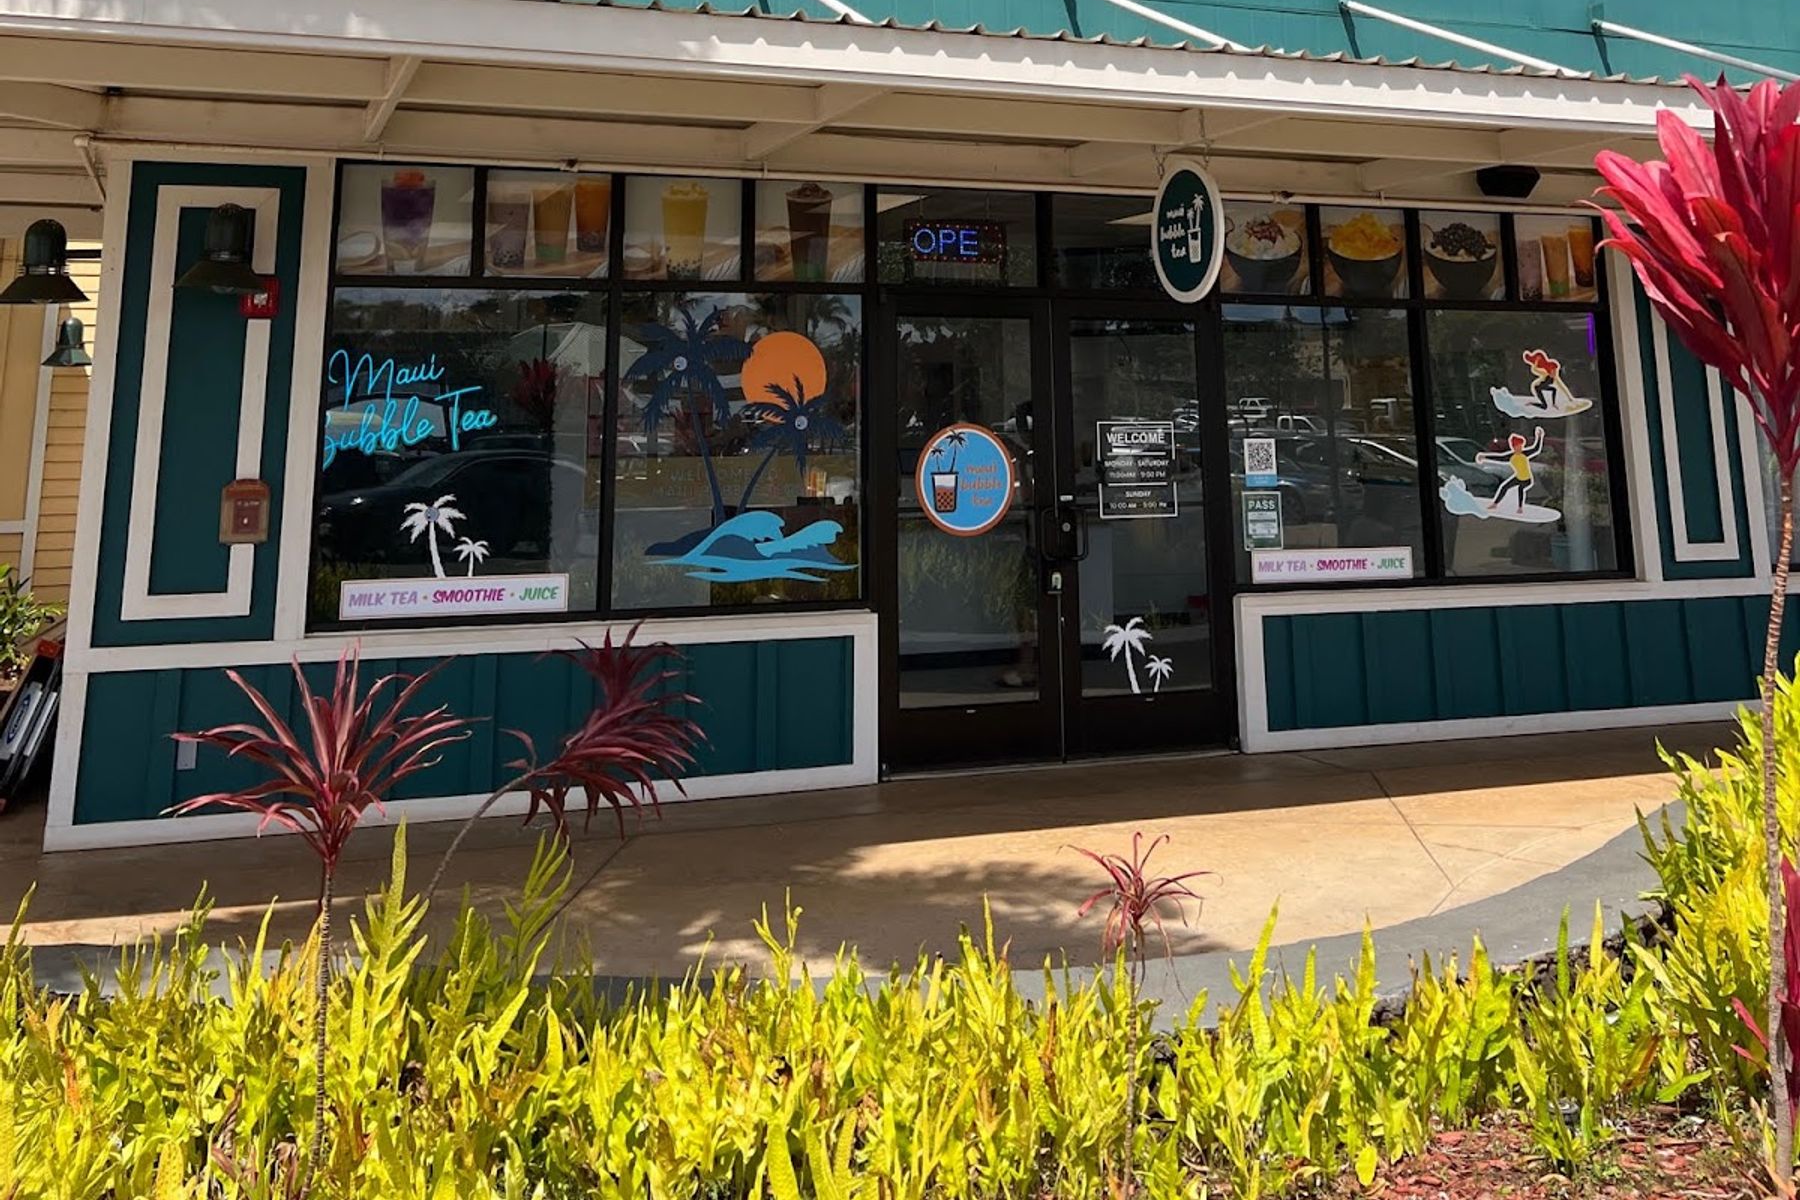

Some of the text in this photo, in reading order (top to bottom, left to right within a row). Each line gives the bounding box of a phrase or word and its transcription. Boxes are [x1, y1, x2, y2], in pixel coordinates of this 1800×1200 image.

[1160, 222, 1186, 242] bubble
[1171, 243, 1187, 259] tea
[328, 349, 446, 411] Maui
[434, 385, 498, 452] Tea
[1106, 432, 1165, 444] WELCOME
[1137, 459, 1169, 467] SATURDAY
[1125, 490, 1152, 498] SUNDAY
[1248, 500, 1276, 510] PASS
[1258, 558, 1405, 573] MILK TEA SMOOTHIE JUICE
[348, 586, 560, 607] MILK TEA SMOOTHIE JUICE
